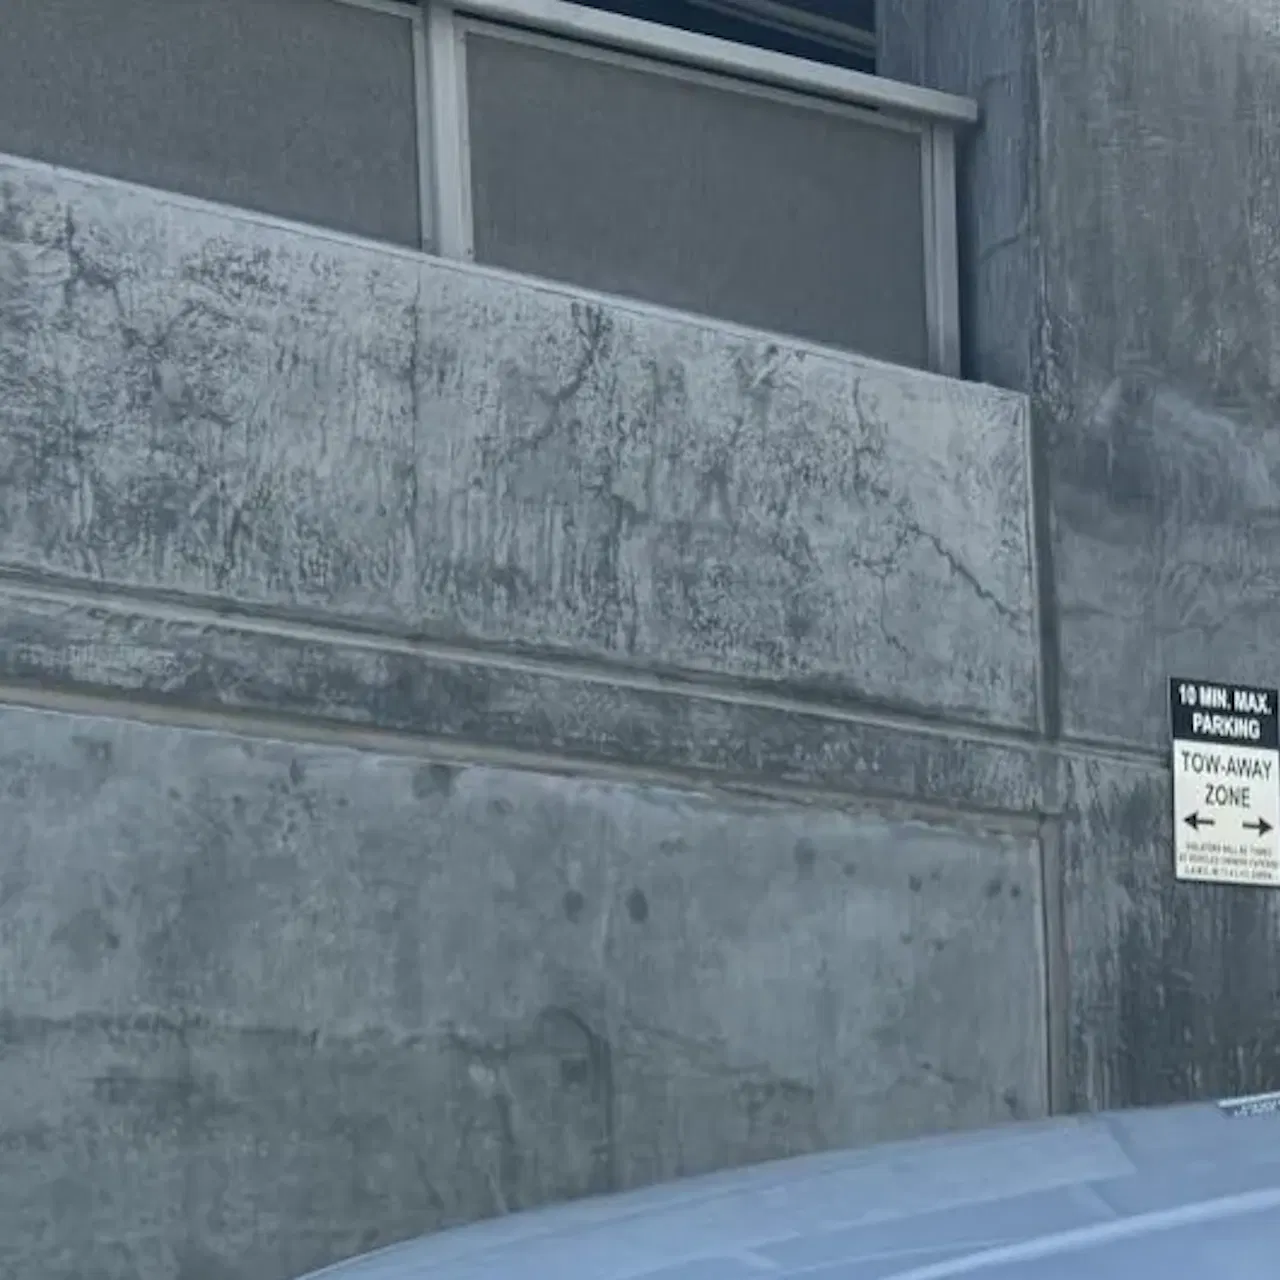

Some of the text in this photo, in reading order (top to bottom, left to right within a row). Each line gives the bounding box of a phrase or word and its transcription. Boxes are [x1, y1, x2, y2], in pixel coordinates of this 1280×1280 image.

[1179, 684, 1272, 715] 10 MIN. MAX.
[1192, 712, 1260, 739] PARKING
[1181, 751, 1272, 780] TOW-AWAY
[1206, 784, 1250, 808] ZONE
